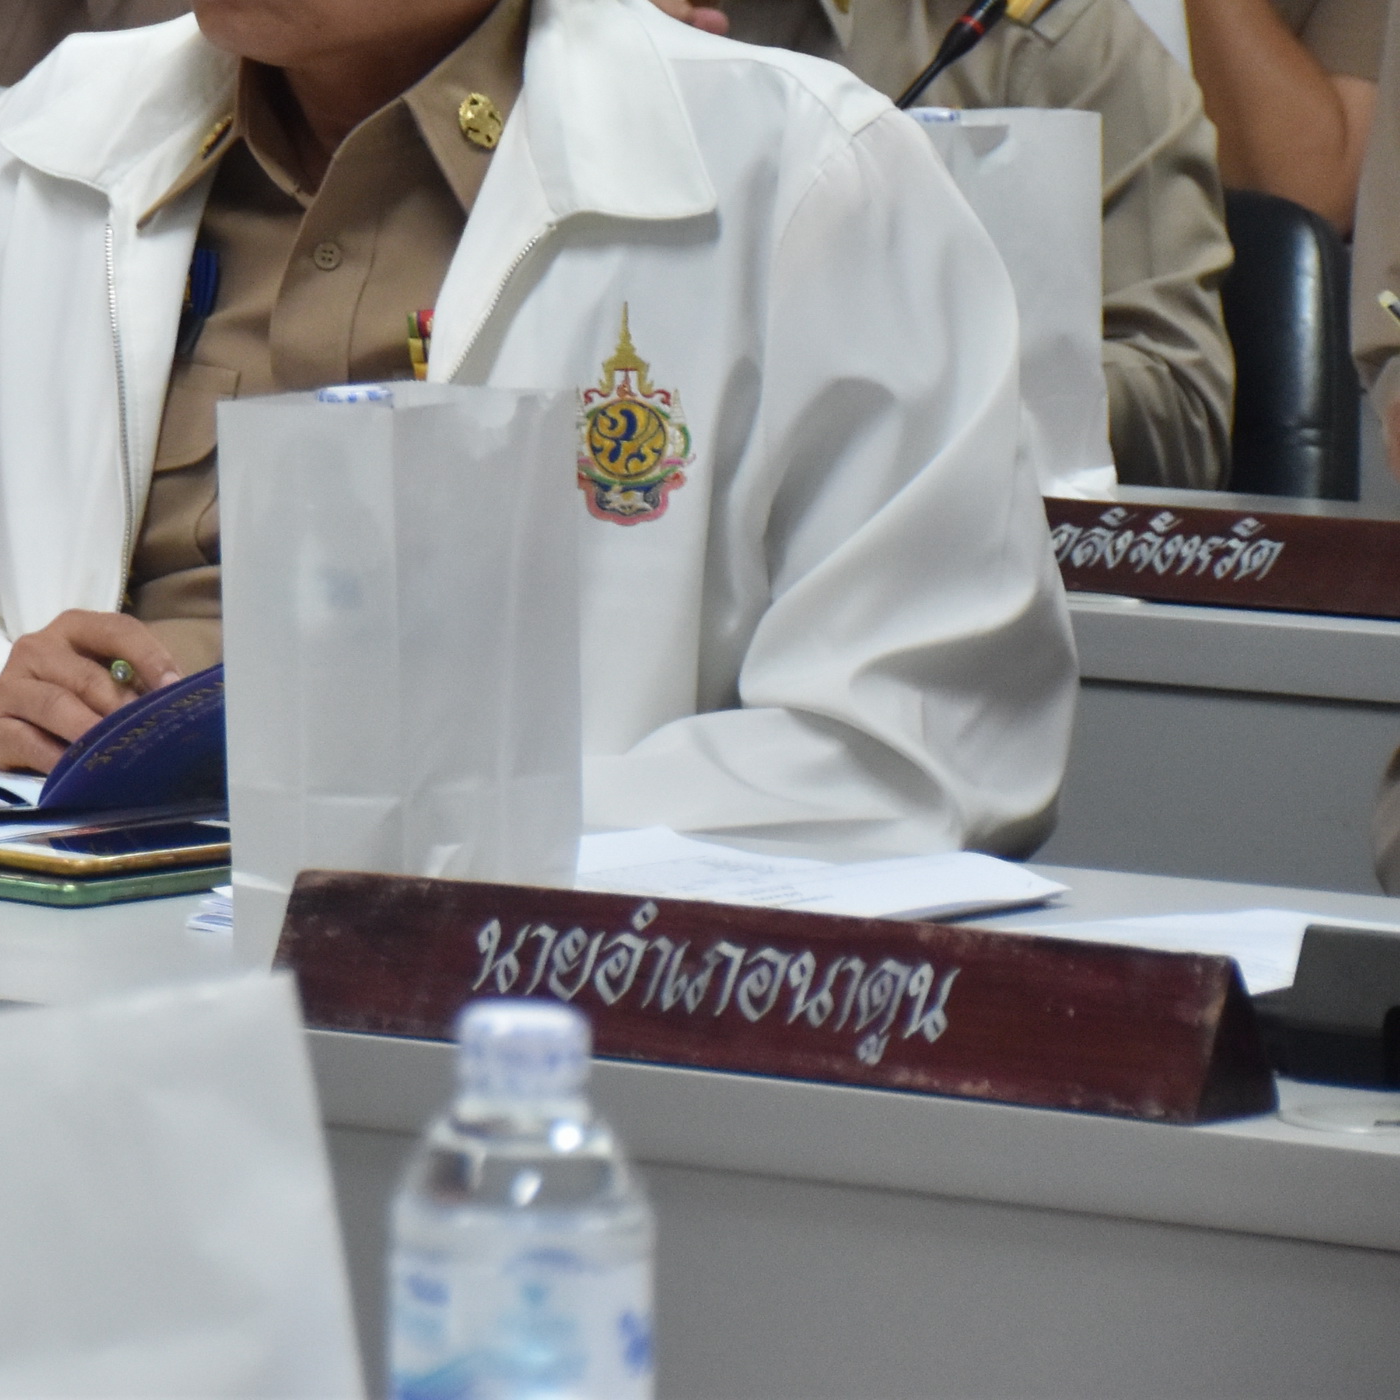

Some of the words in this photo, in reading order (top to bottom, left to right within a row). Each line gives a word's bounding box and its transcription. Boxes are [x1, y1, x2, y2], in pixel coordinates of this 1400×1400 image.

[471, 900, 961, 1066] นายอำเภอนาดูน
